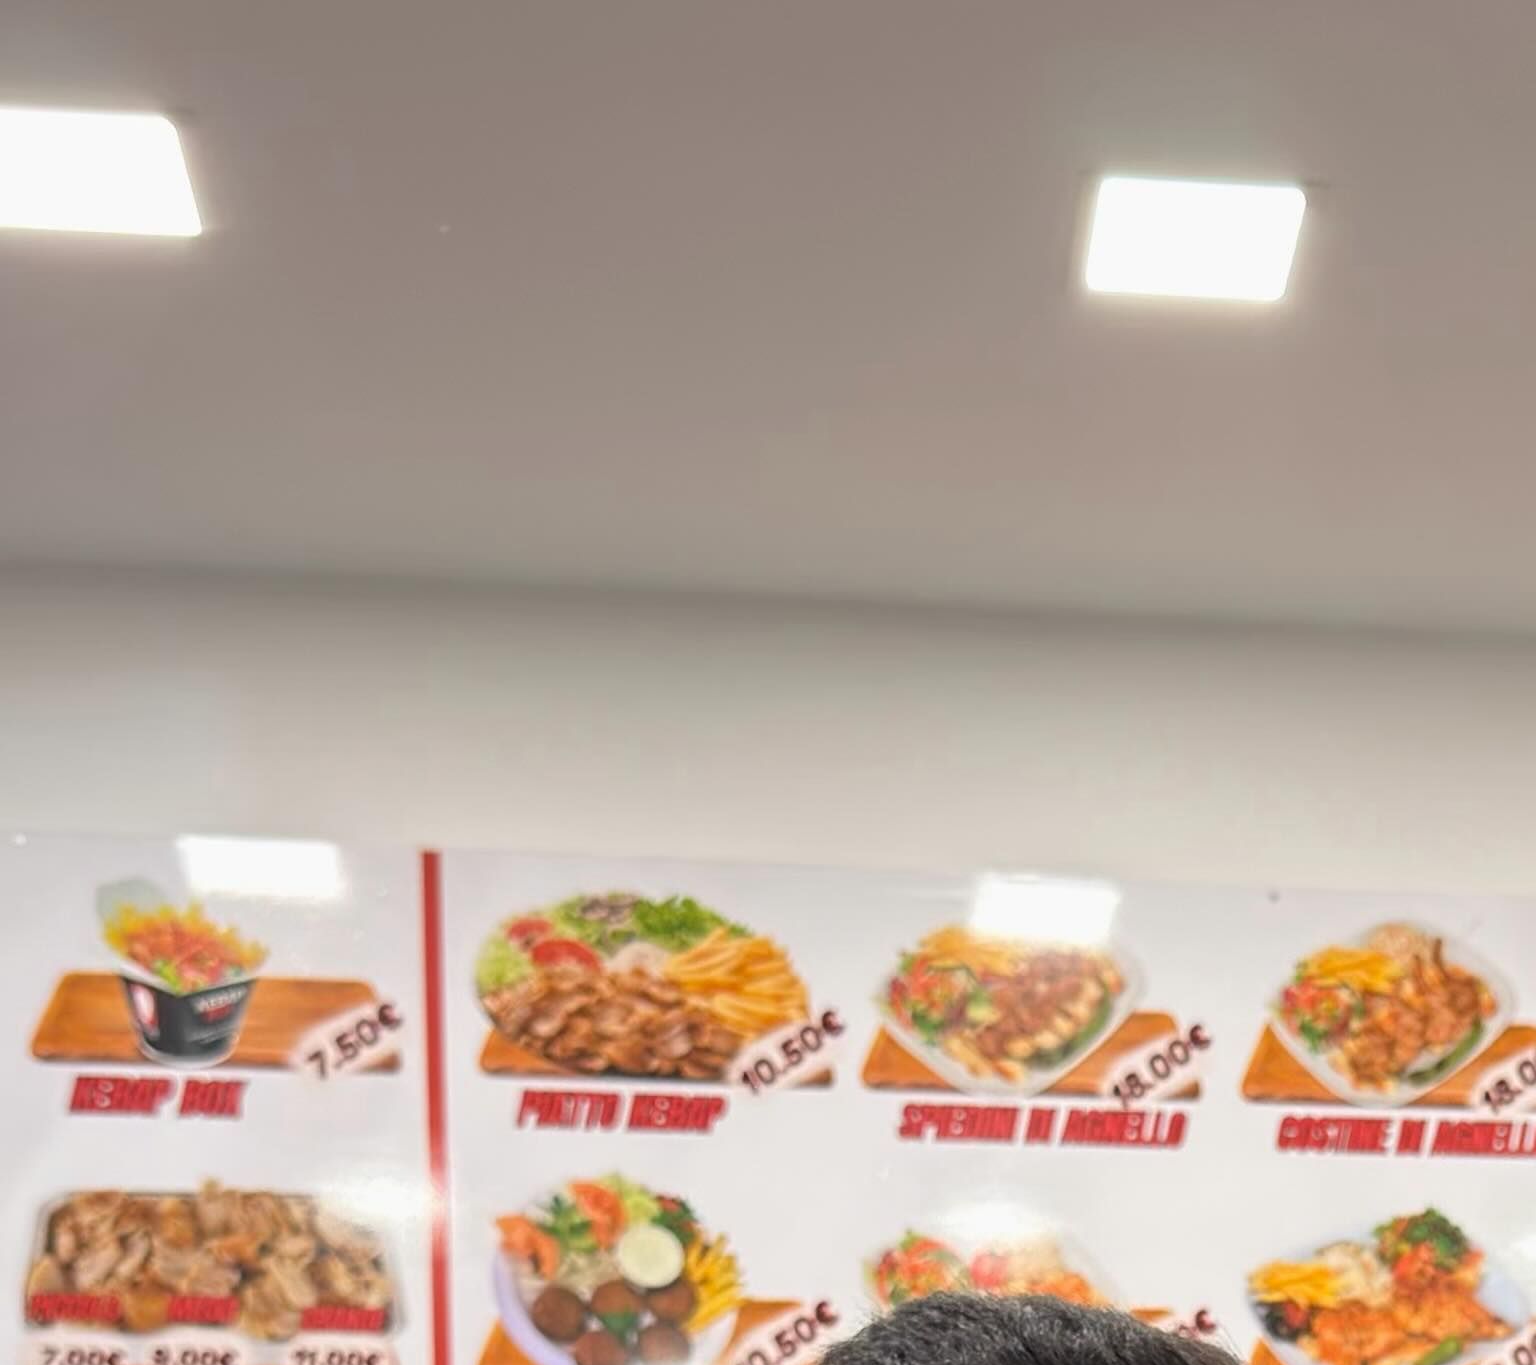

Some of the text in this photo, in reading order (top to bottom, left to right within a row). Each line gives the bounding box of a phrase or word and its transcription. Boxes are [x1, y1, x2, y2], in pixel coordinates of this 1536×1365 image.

[307, 1003, 403, 1079] 7.50€
[741, 1009, 846, 1093] 10.50€
[1113, 1024, 1213, 1107] 18.00€
